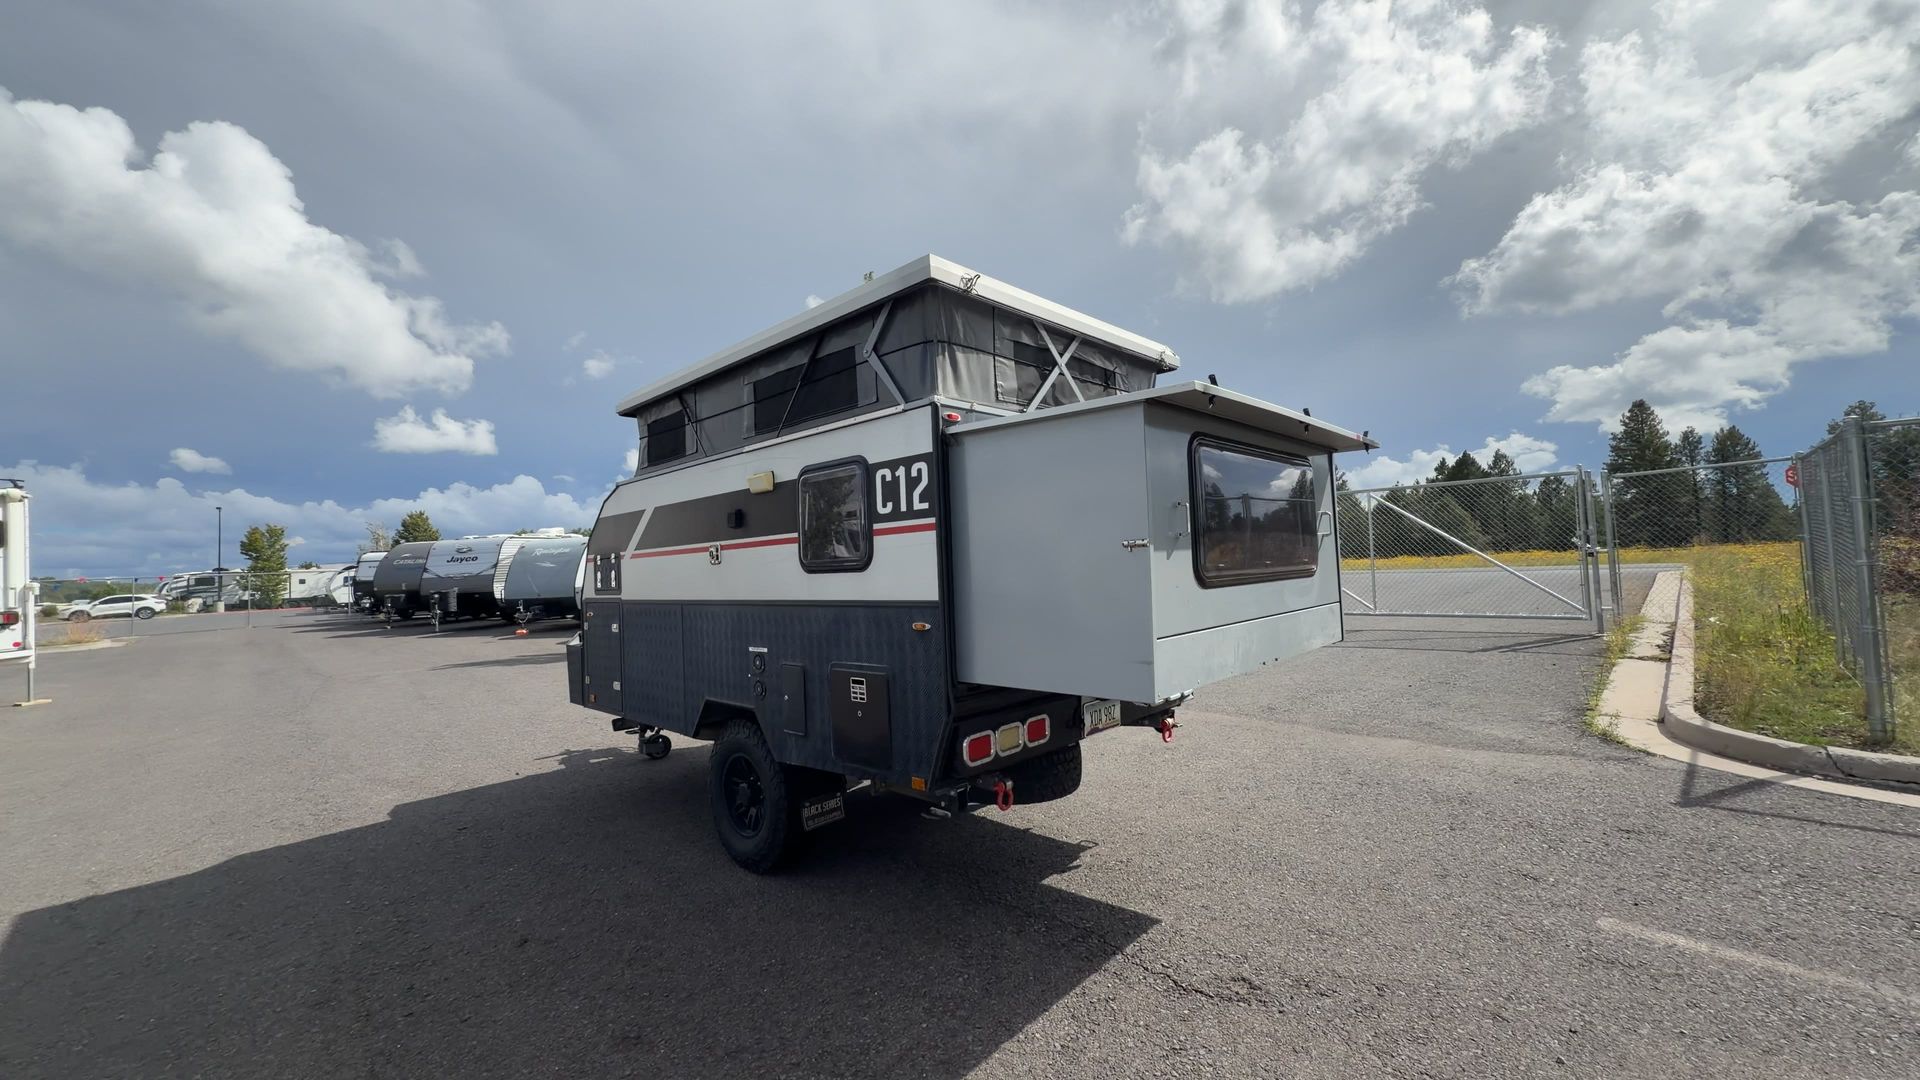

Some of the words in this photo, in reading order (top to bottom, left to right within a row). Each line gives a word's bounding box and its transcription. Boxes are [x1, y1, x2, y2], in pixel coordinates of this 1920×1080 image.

[875, 461, 929, 514] C12
[446, 555, 479, 563] Jayco
[804, 803, 822, 817] BLACK
[822, 797, 841, 812] SERIES
